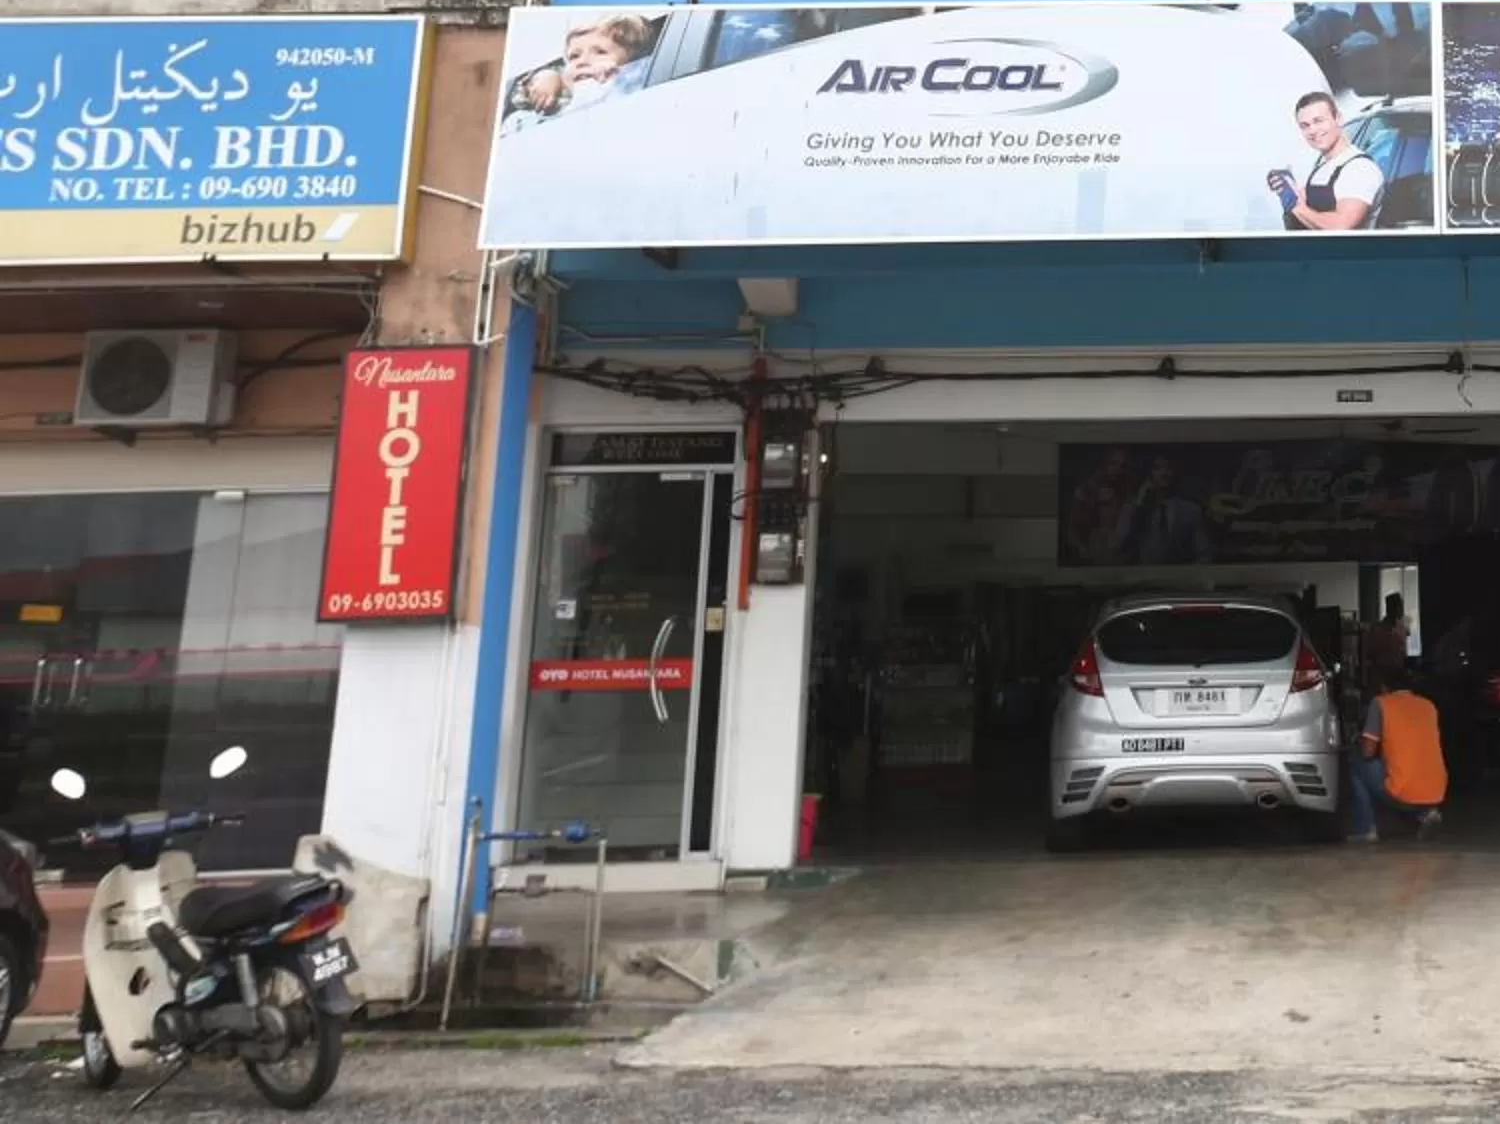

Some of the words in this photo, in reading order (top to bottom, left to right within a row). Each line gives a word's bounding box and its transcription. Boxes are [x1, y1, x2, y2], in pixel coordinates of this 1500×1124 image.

[275, 47, 375, 67] 942050-M
[0, 127, 37, 173] S
[52, 126, 194, 172] SDN.
[211, 123, 358, 170] BHD.
[806, 131, 876, 153] Giving
[881, 131, 923, 150] You
[928, 130, 983, 149] What
[989, 130, 1030, 148] You
[1035, 129, 1122, 148] Deserve
[999, 153, 1031, 165] More
[48, 178, 103, 202] NO.
[113, 176, 176, 201] TEL
[199, 175, 288, 201] 09-690
[294, 174, 357, 198] 3840
[180, 212, 317, 246] bizhub
[378, 389, 421, 585] HOTEL
[328, 590, 443, 614] 09-6903035
[539, 668, 569, 681] OYO
[572, 668, 609, 681] HOTEL
[611, 667, 682, 680] NUSANARA
